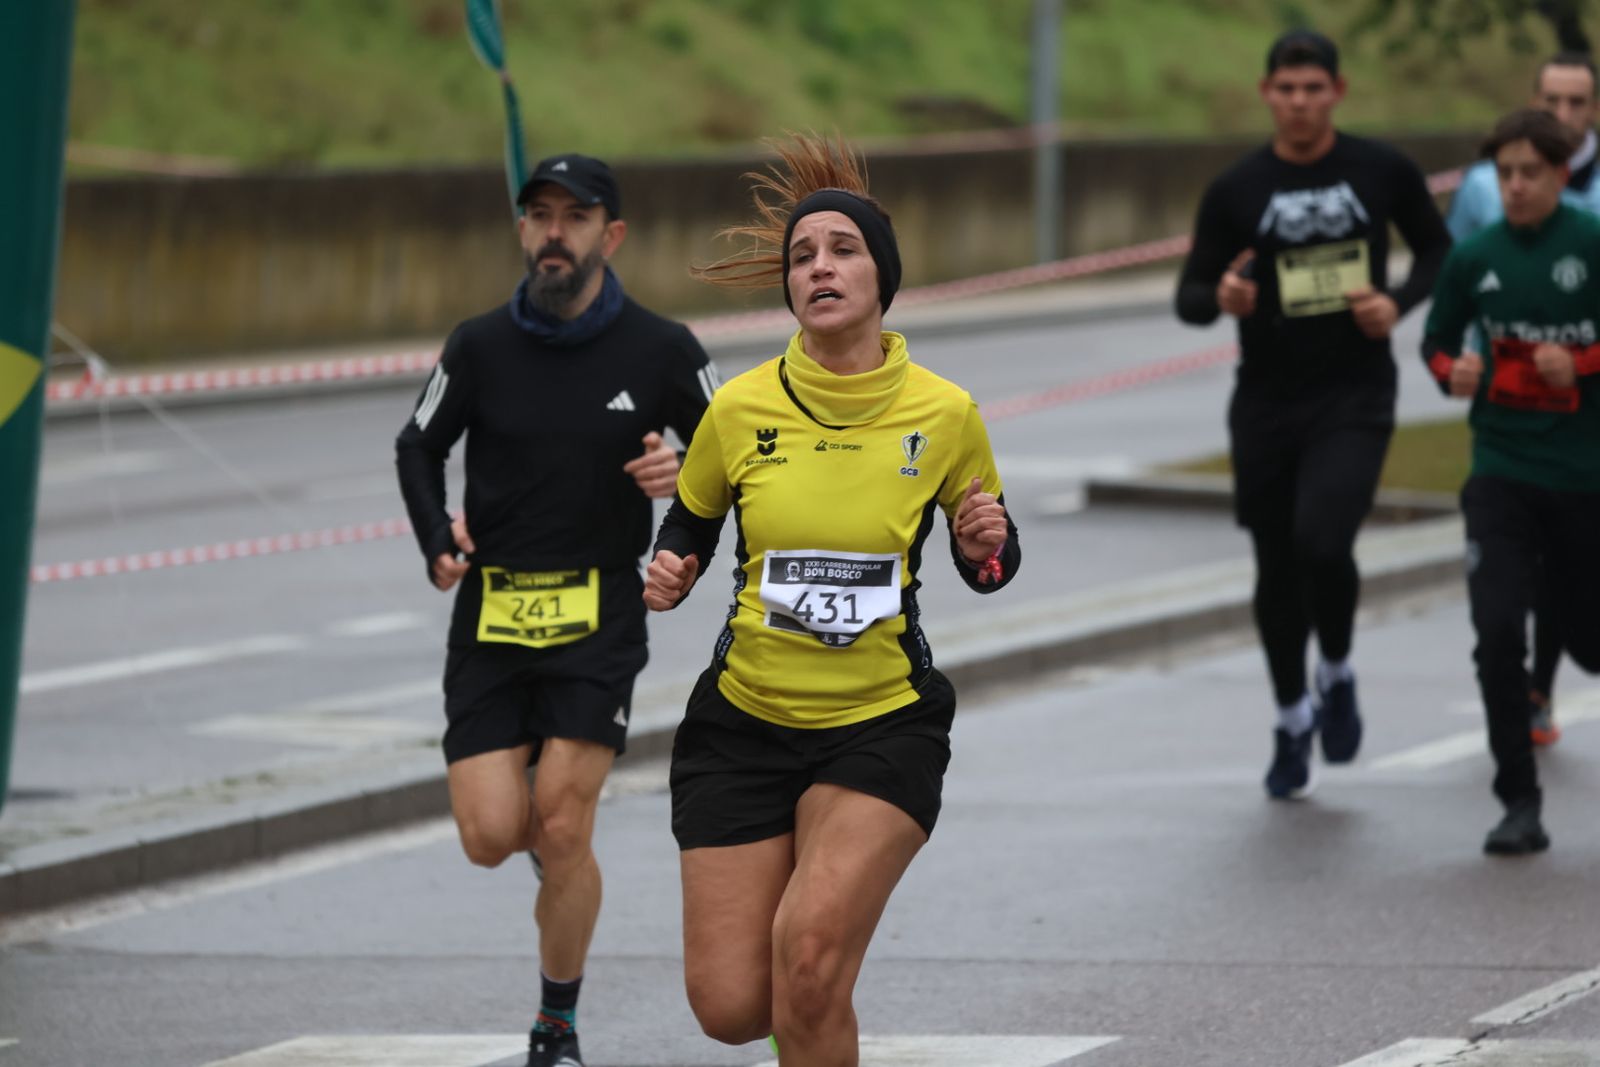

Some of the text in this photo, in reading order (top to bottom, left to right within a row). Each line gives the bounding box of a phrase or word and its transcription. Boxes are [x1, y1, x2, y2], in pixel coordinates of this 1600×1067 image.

[900, 467, 919, 476] GCB
[821, 561, 852, 570] CARRERA
[852, 563, 882, 571] POPULAR
[804, 567, 826, 577] DON
[827, 568, 863, 580] BOSCO
[510, 596, 565, 622] 241
[792, 591, 864, 624] 431
